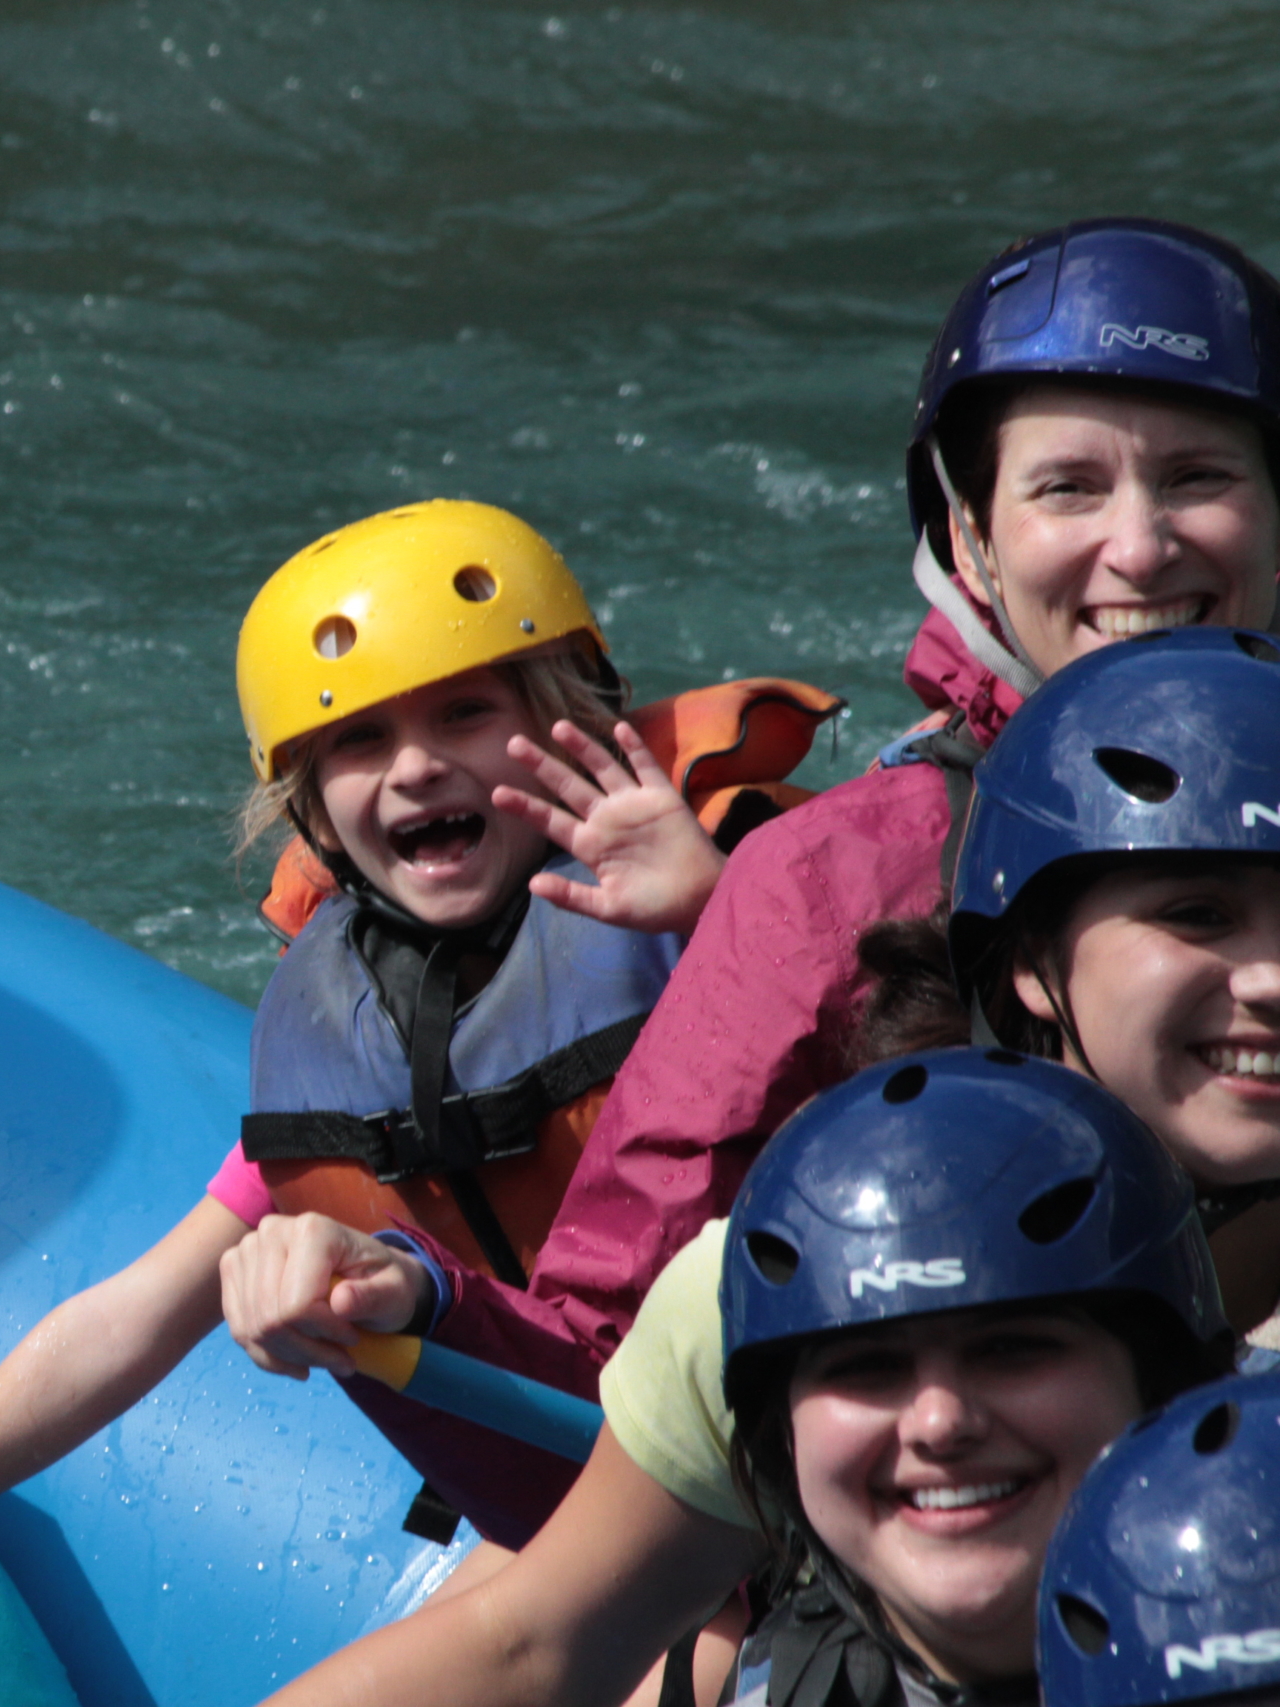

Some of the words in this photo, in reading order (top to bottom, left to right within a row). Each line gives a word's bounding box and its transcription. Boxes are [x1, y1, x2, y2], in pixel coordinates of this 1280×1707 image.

[1100, 323, 1210, 361] NRS
[850, 1258, 966, 1299] NRS
[1165, 1628, 1280, 1679] NRS
